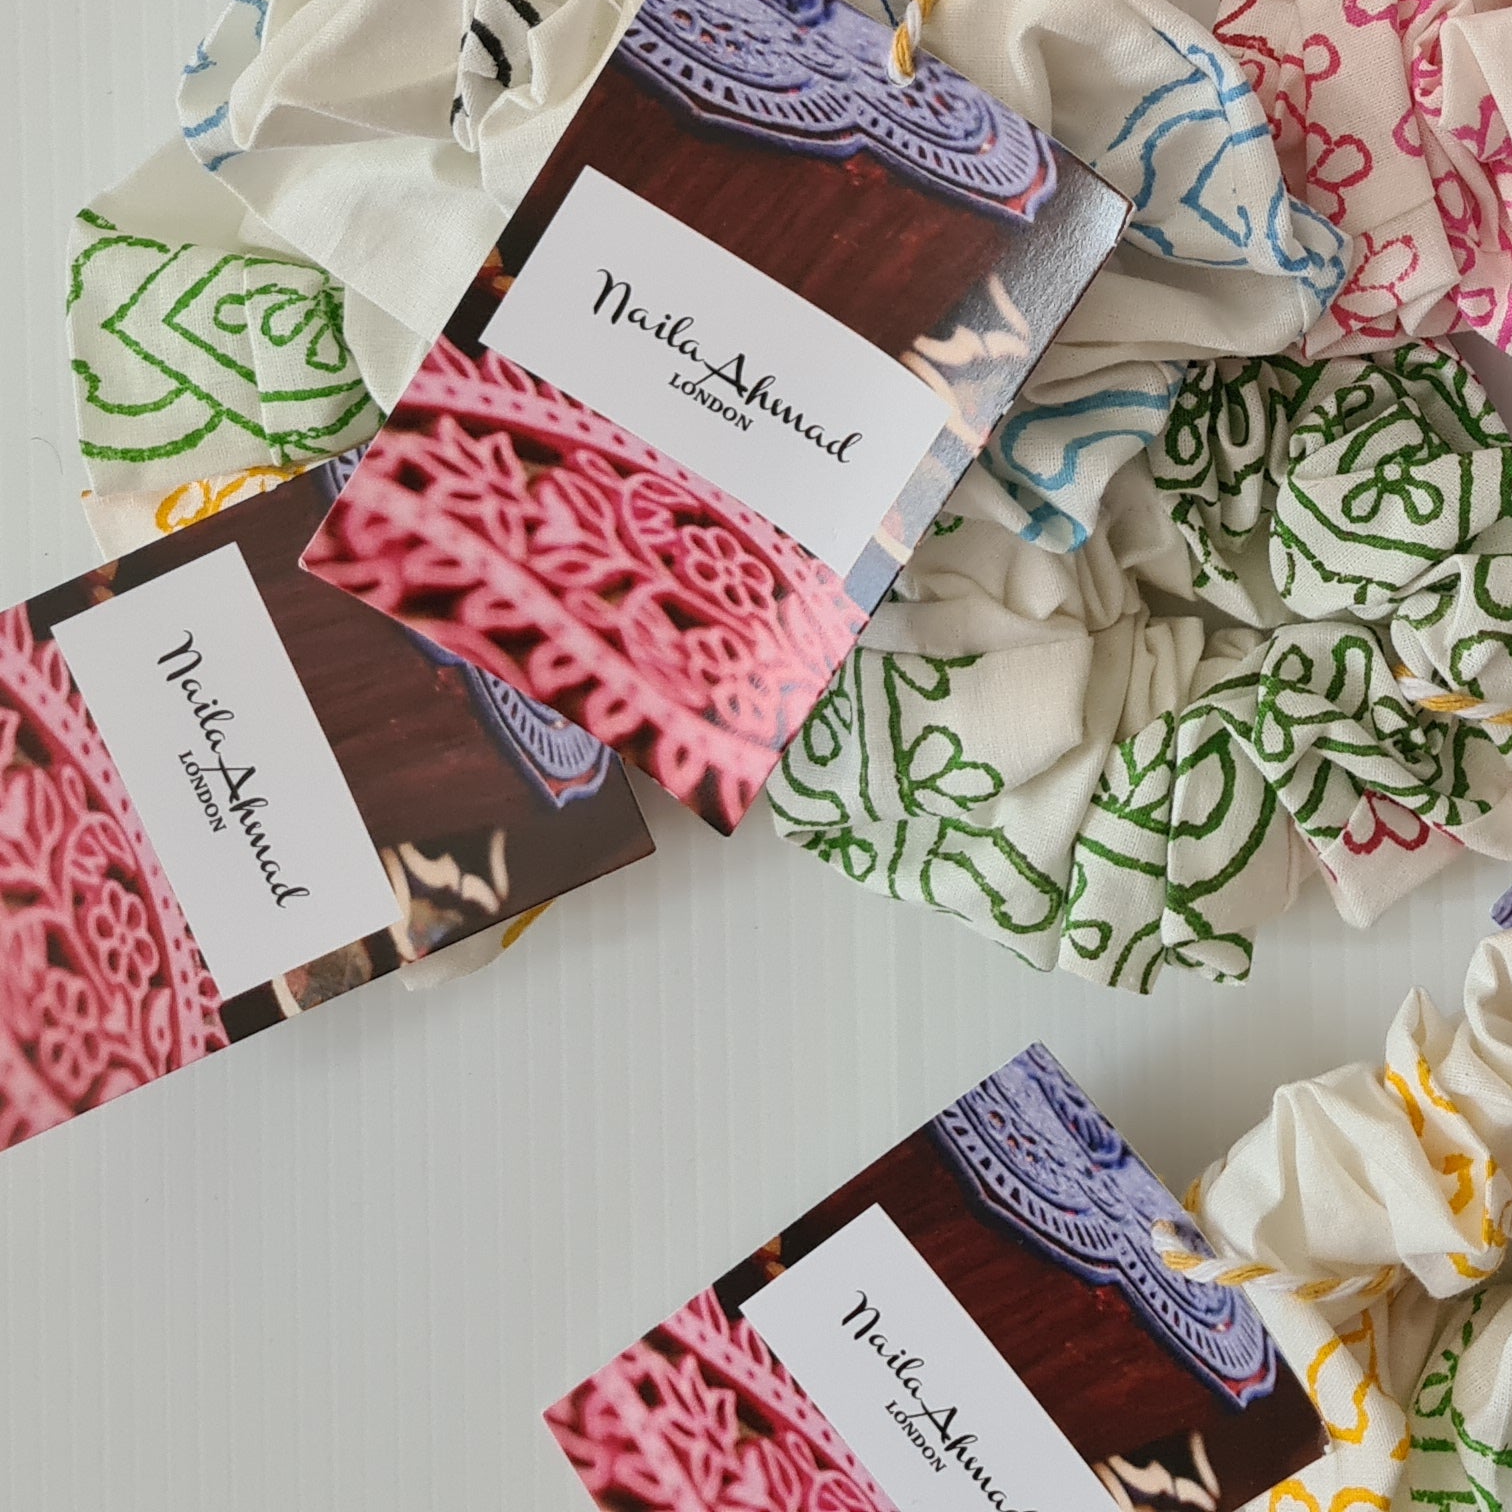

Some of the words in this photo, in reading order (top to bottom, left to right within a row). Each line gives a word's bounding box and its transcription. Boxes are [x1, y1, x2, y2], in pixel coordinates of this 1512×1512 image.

[593, 268, 705, 363] Naila
[695, 353, 863, 464] Ahmad
[668, 372, 754, 432] LONDON
[157, 629, 235, 754] Naila
[199, 752, 310, 909] Ahmad
[178, 749, 227, 833] LONDON
[841, 1290, 925, 1400] Naila
[906, 1399, 1040, 1512] Ahma
[885, 1399, 947, 1473] LONDON
